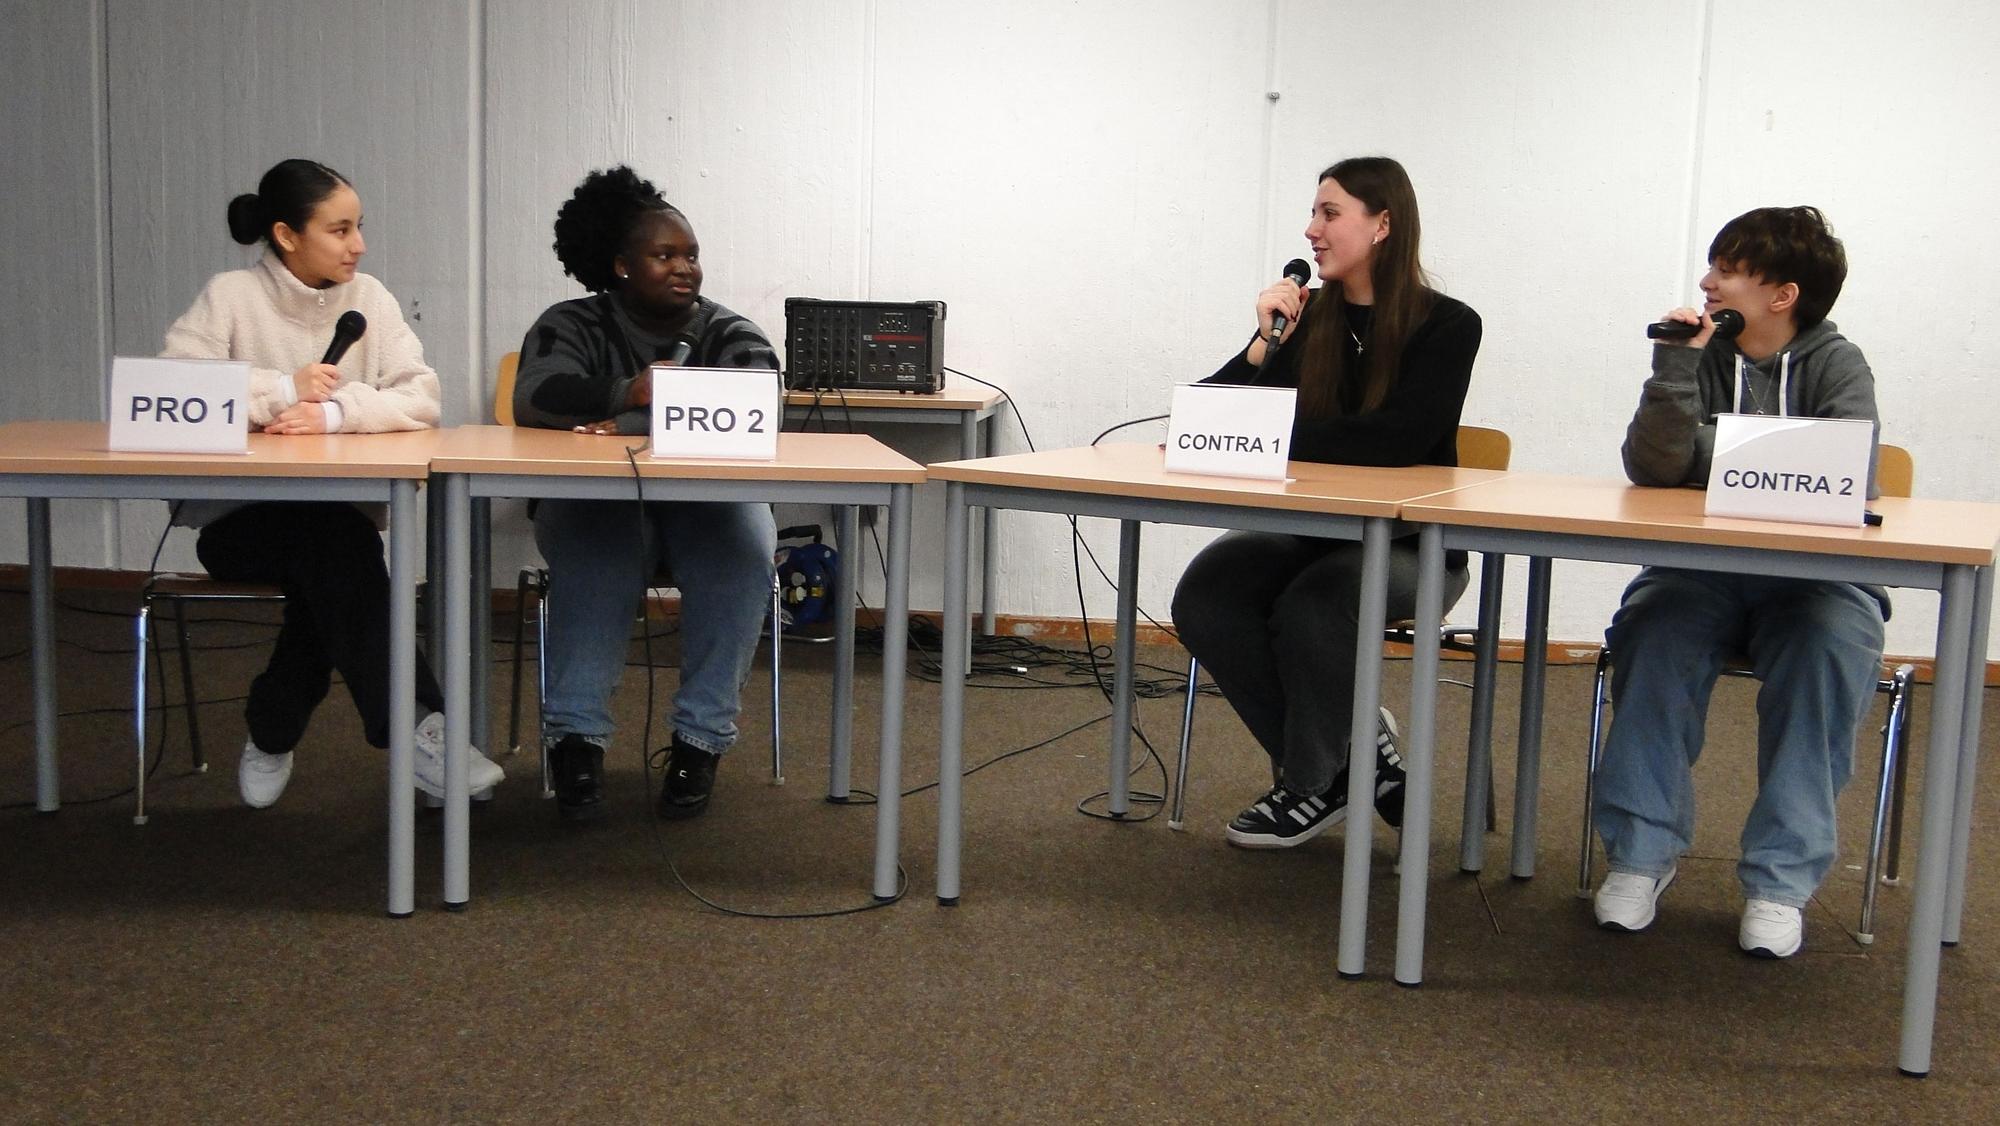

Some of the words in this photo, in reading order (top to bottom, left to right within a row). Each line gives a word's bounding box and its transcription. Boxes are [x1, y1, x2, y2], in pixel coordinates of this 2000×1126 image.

[130, 395, 208, 424] PRO
[222, 398, 235, 425] 1
[665, 406, 736, 433] PRO
[747, 409, 764, 434] 2
[1178, 433, 1264, 453] CONTRA
[1272, 438, 1280, 454] 1
[1723, 469, 1831, 495] CONTRA
[1839, 477, 1853, 496] 2
